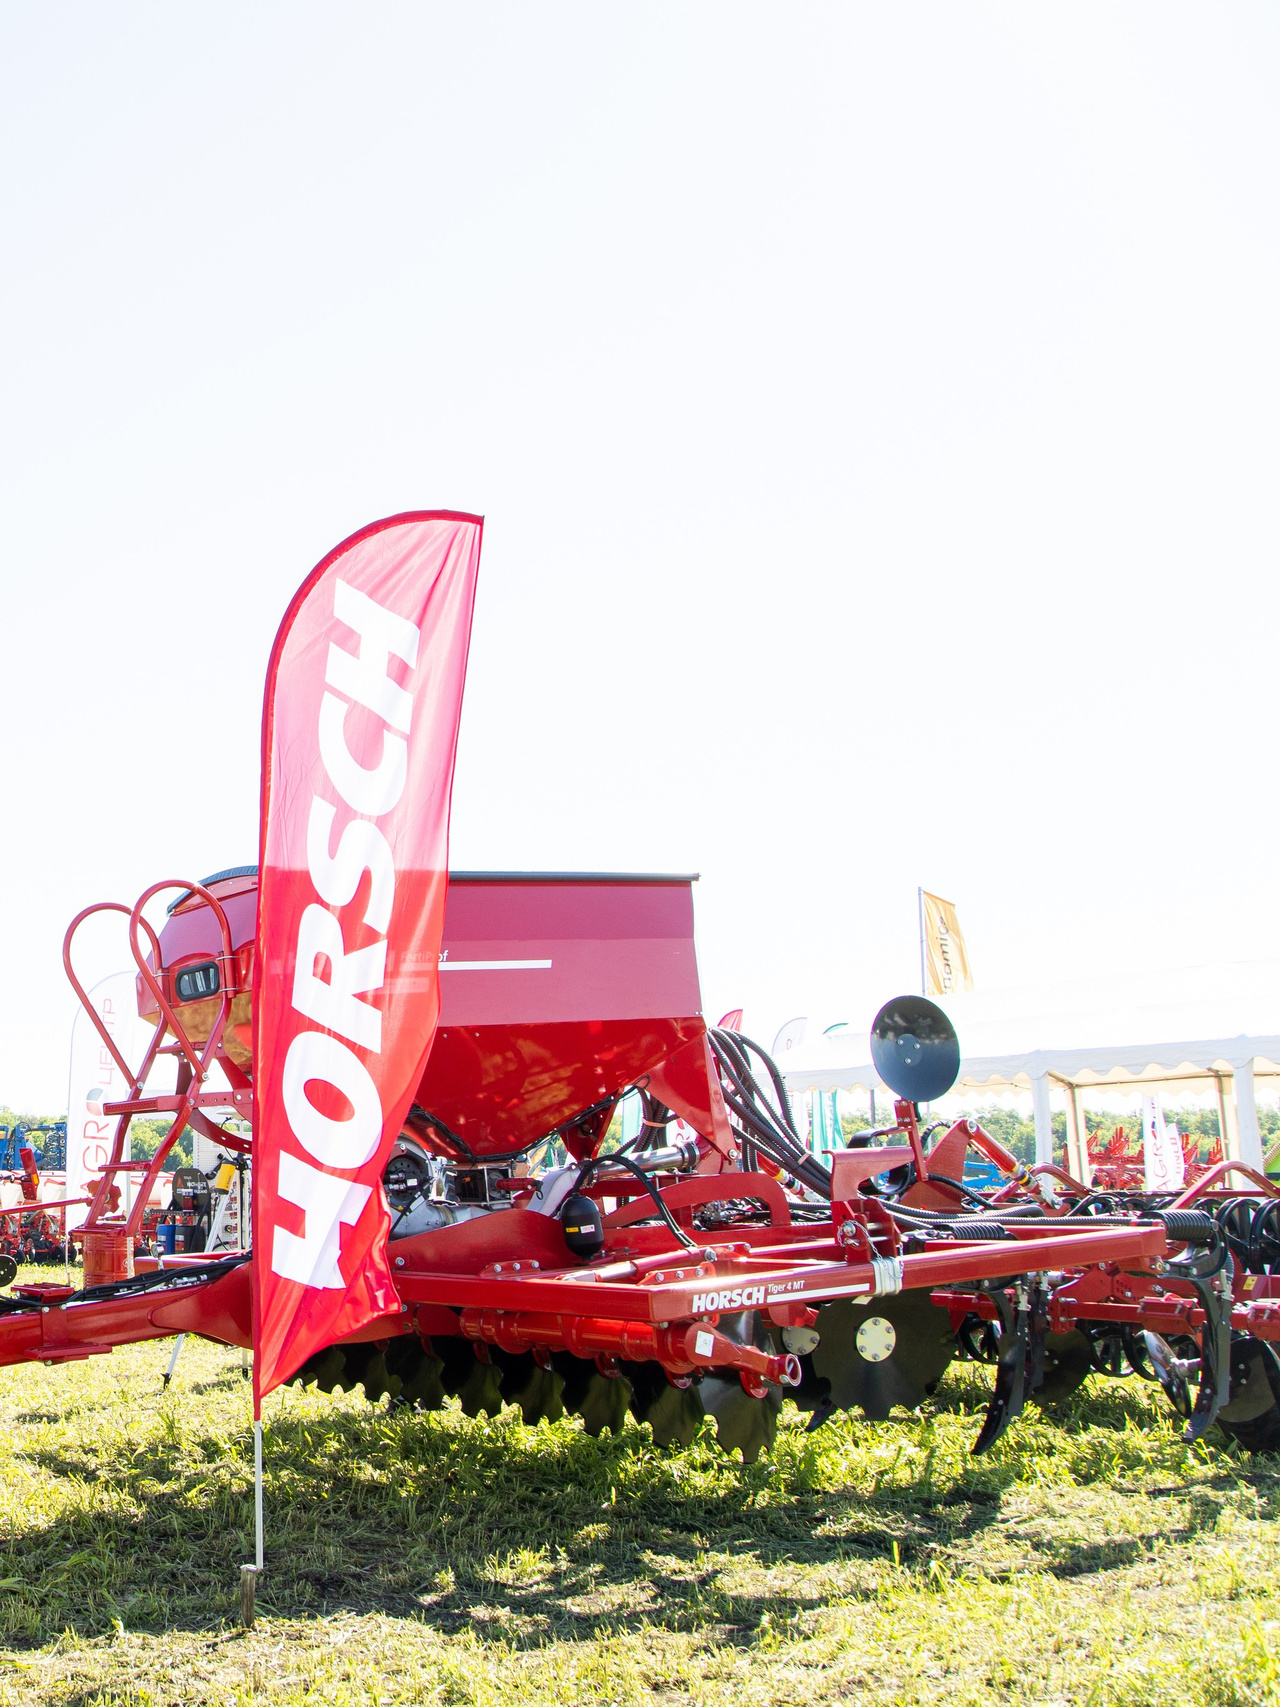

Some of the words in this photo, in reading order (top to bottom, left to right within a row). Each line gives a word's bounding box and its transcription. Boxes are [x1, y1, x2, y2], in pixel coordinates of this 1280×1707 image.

[271, 578, 421, 1290] HORSCH
[692, 1286, 765, 1313] HORSCH
[768, 1283, 786, 1294] Tiger
[786, 1281, 792, 1290] 4
[793, 1280, 806, 1290] MT
